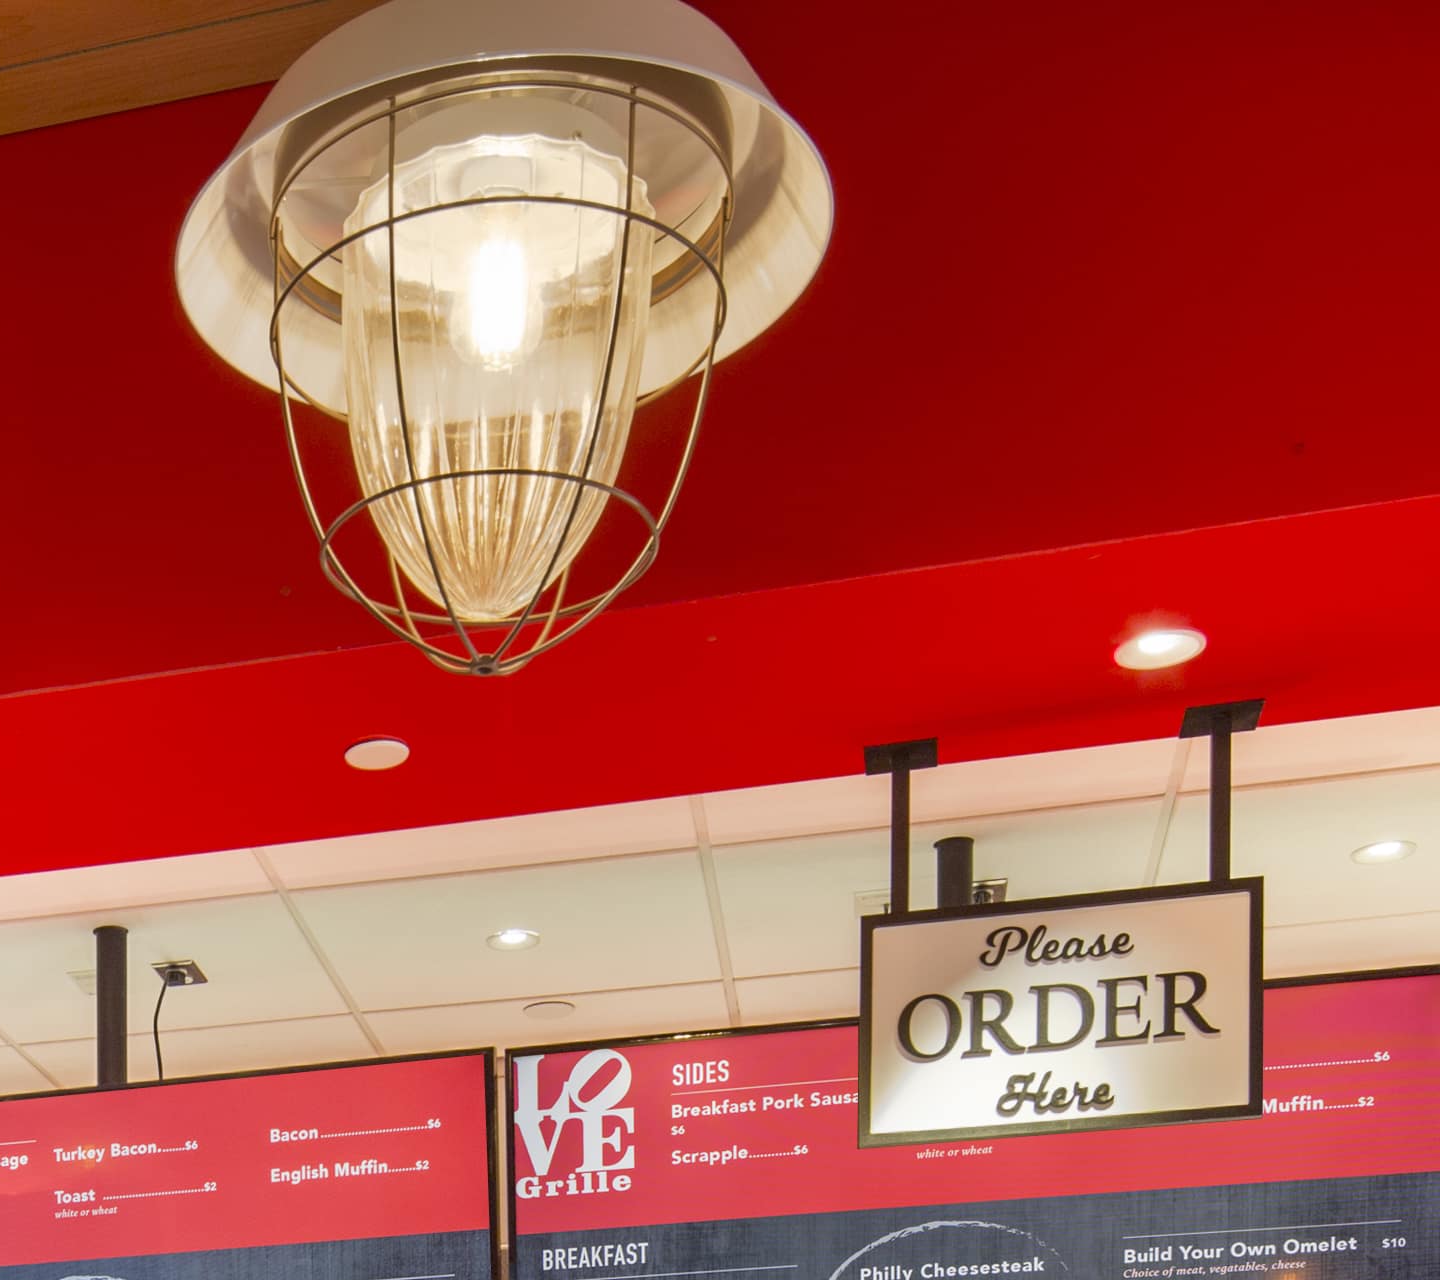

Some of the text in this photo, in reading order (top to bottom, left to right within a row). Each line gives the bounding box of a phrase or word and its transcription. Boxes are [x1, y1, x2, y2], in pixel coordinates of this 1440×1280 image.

[979, 924, 1134, 969] Please
[896, 971, 1222, 1062] ORDER
[996, 1071, 1115, 1117] Here
[270, 1126, 318, 1143] Bacon
[53, 1147, 105, 1164] Turkey
[270, 1162, 328, 1185] English
[516, 1171, 632, 1199] Grille
[54, 1188, 95, 1204] Toast
[54, 1206, 117, 1220] white or wheat
[1124, 1237, 1357, 1264] Build Your Own Omelet
[920, 1257, 1044, 1279] Cheesesteak
